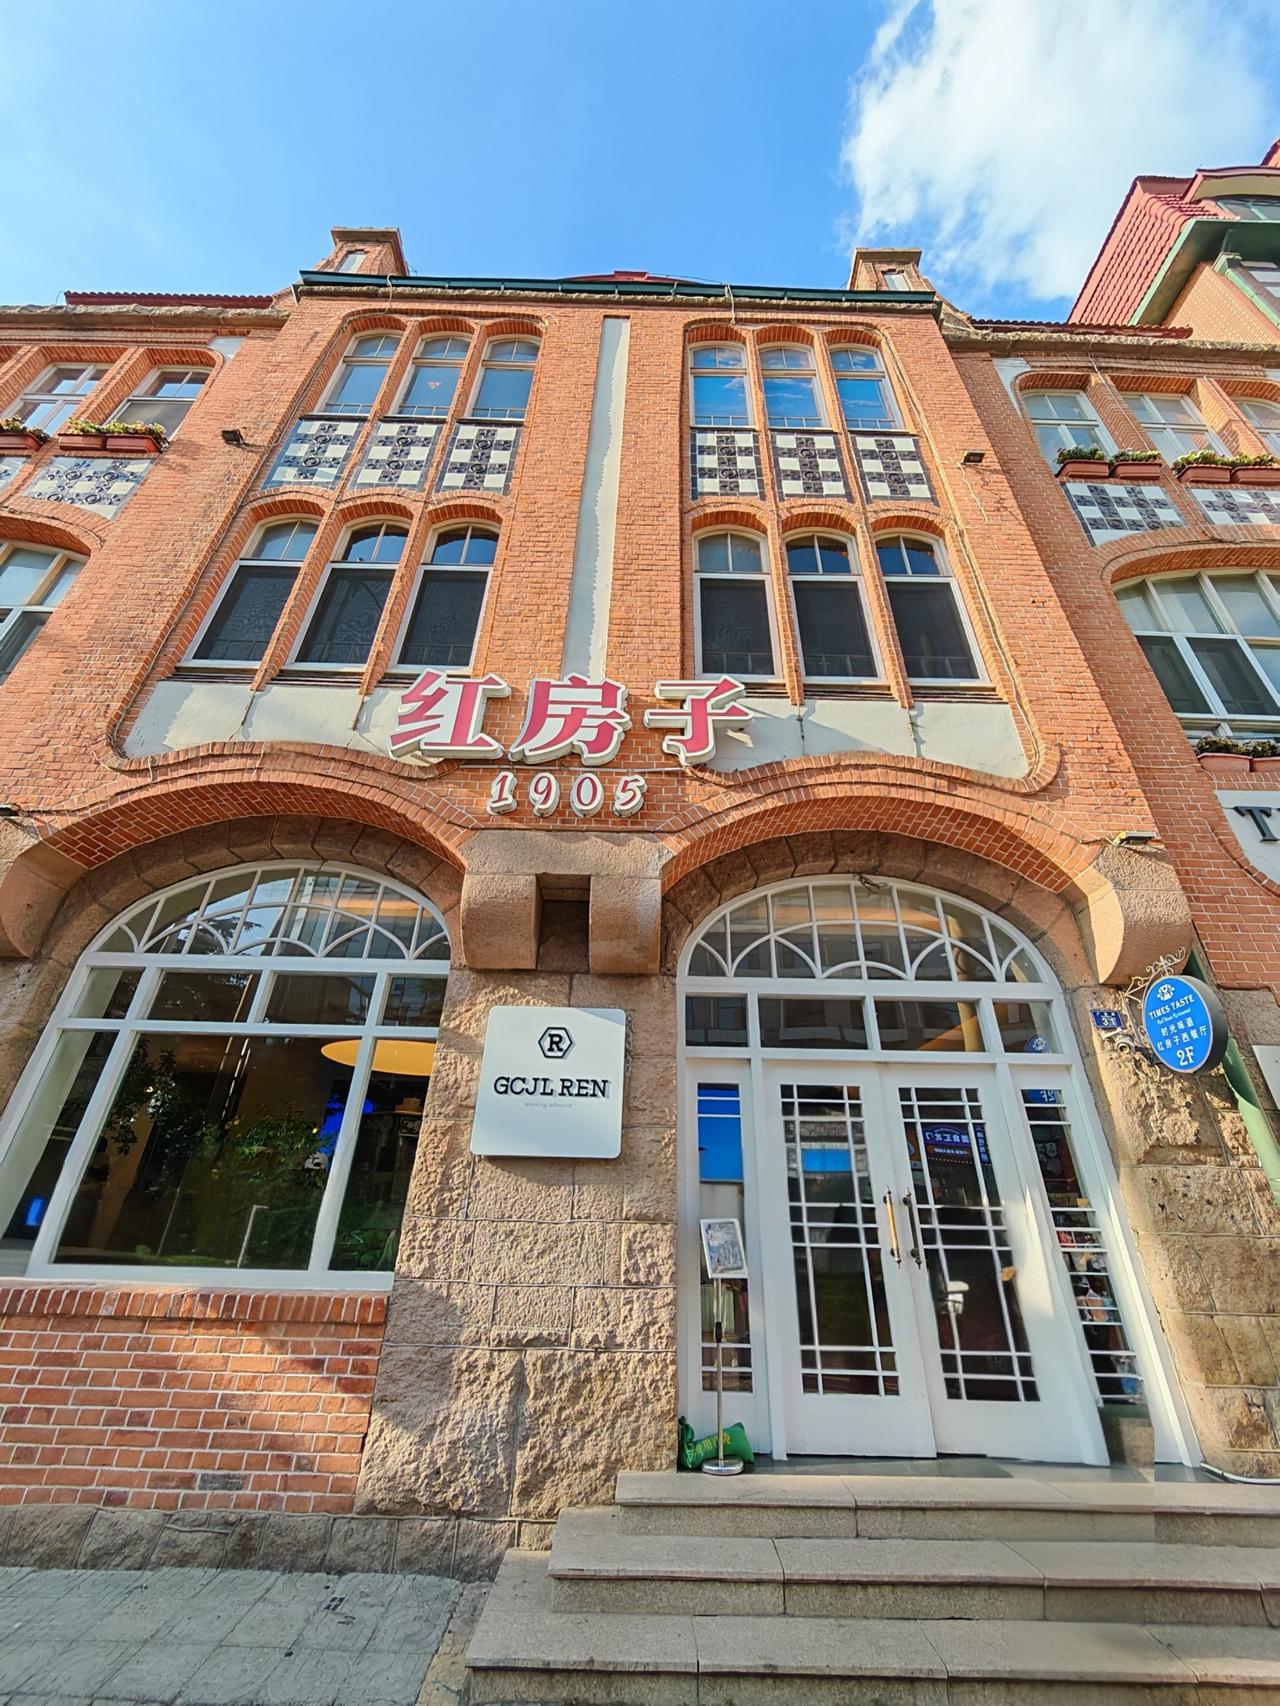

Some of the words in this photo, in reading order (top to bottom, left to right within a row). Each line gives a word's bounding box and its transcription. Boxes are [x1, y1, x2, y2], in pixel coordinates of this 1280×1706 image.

[389, 668, 754, 766] 红房子
[487, 771, 648, 817] 1905
[1149, 1005, 1171, 1020] TIMES
[1171, 994, 1195, 1010] TASTE
[1156, 1025, 1208, 1051] 红房子西餐厅
[1160, 1016, 1194, 1037] 时光味道
[547, 1033, 564, 1052] R
[1176, 1046, 1194, 1067] 2F
[493, 1076, 554, 1096] GCJL
[558, 1078, 609, 1098] REN
